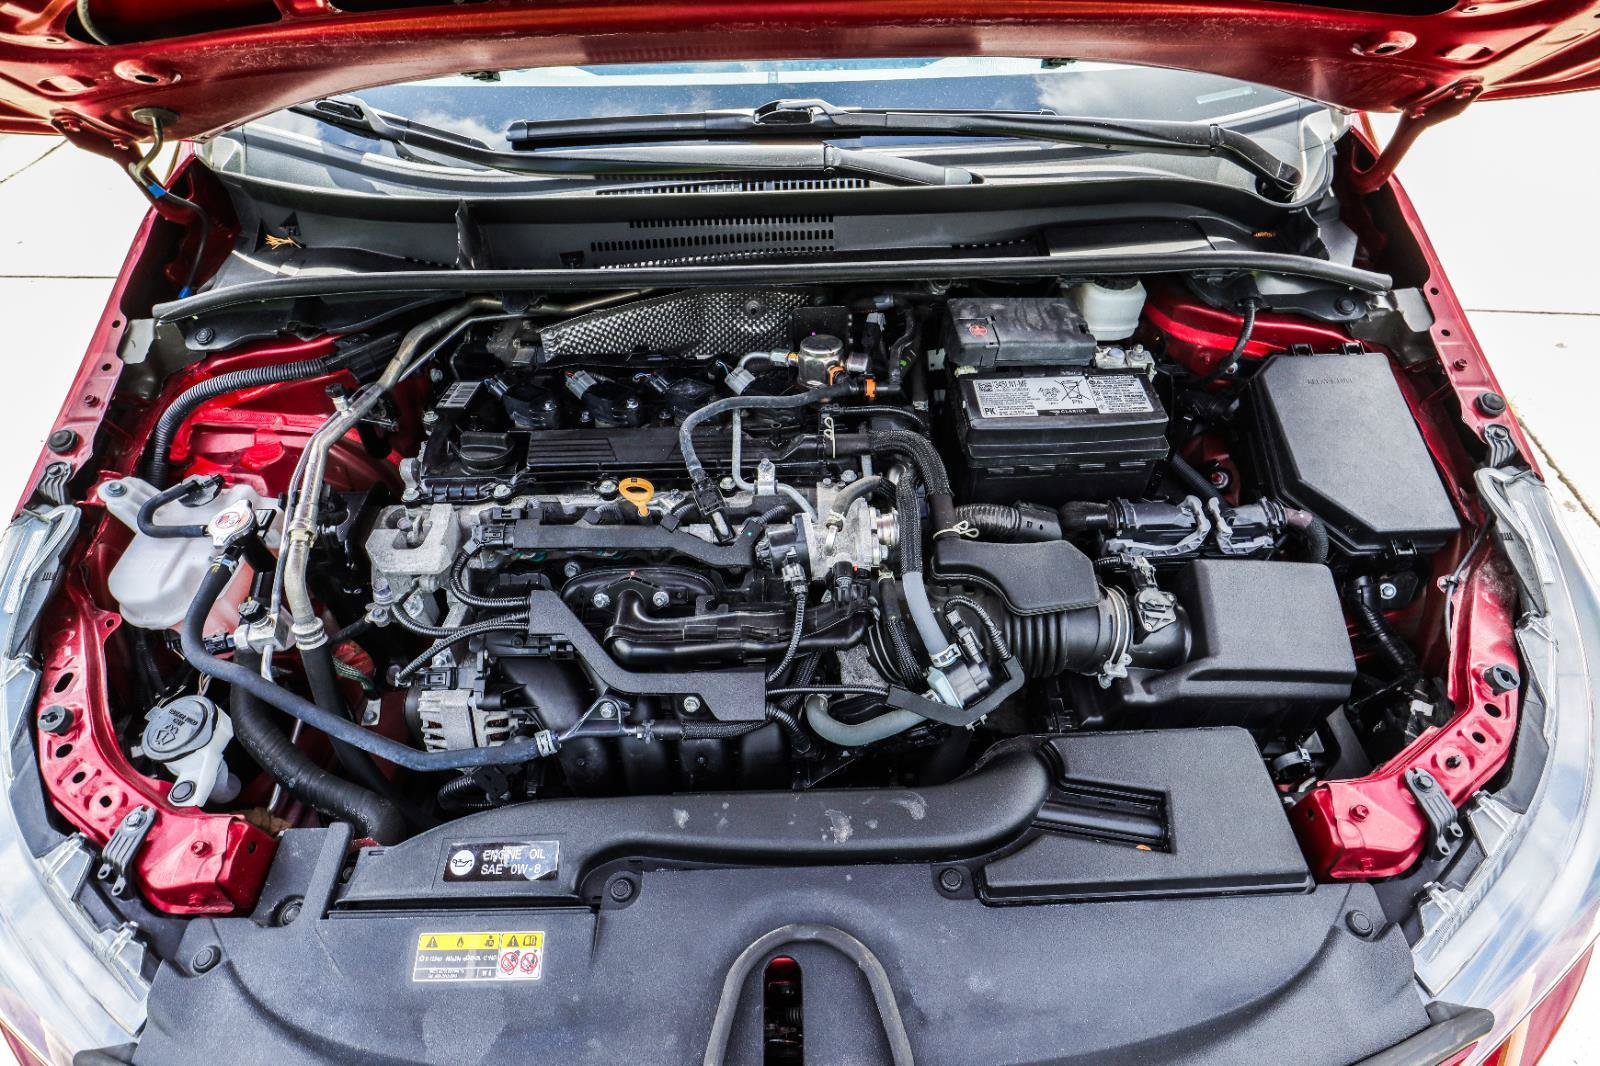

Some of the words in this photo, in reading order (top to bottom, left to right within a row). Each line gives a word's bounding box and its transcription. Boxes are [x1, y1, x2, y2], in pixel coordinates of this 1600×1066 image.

[984, 407, 996, 415] PK
[482, 849, 522, 861] ENGINE
[529, 848, 546, 860] OIL
[480, 864, 503, 875] SAE
[510, 863, 541, 874] 0W-8
